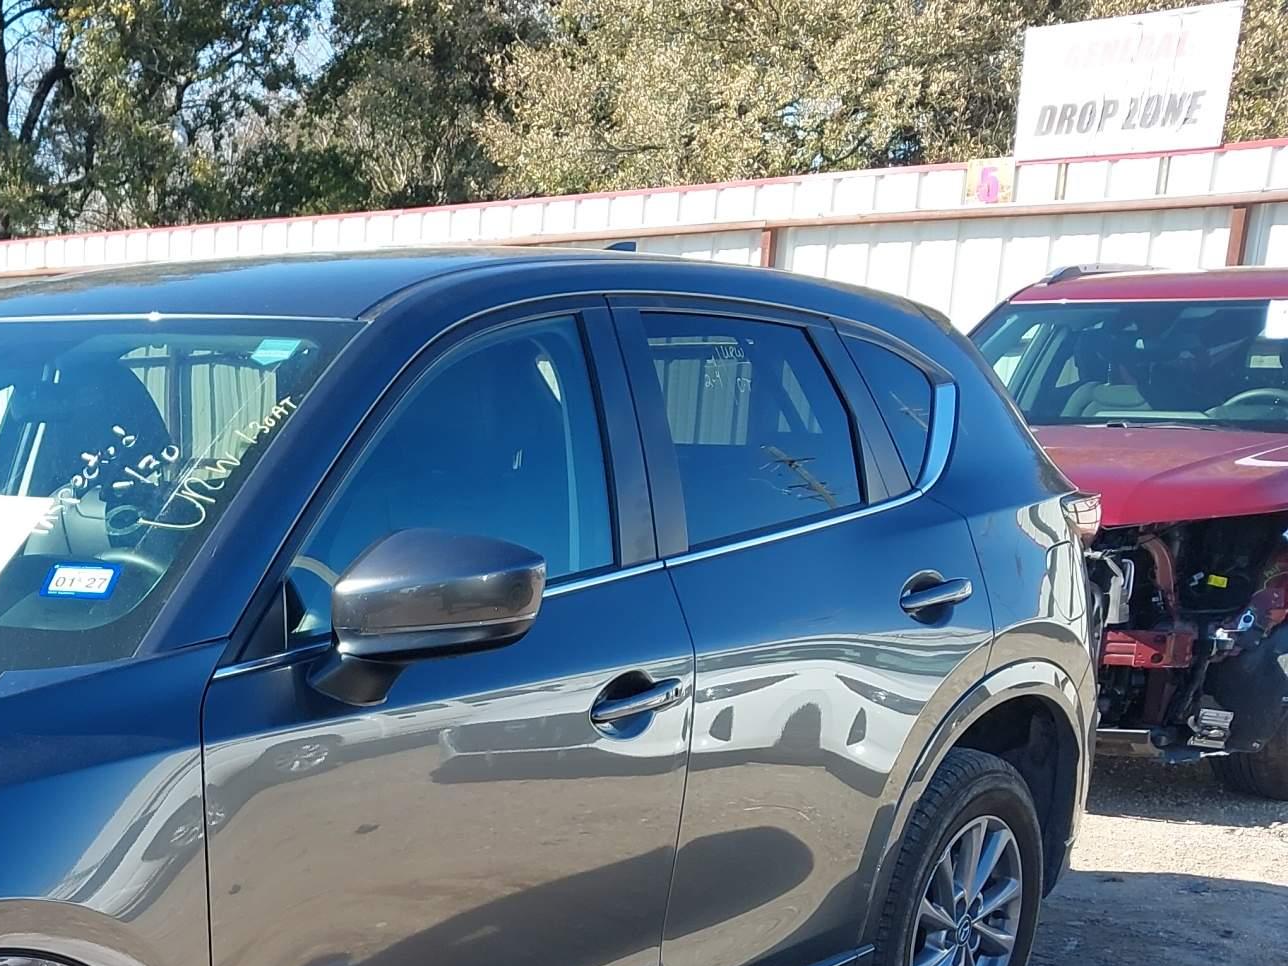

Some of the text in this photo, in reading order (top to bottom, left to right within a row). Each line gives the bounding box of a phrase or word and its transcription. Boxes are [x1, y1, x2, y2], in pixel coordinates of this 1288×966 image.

[1034, 90, 1207, 137] DROP ZONE
[85, 577, 107, 589] 27
